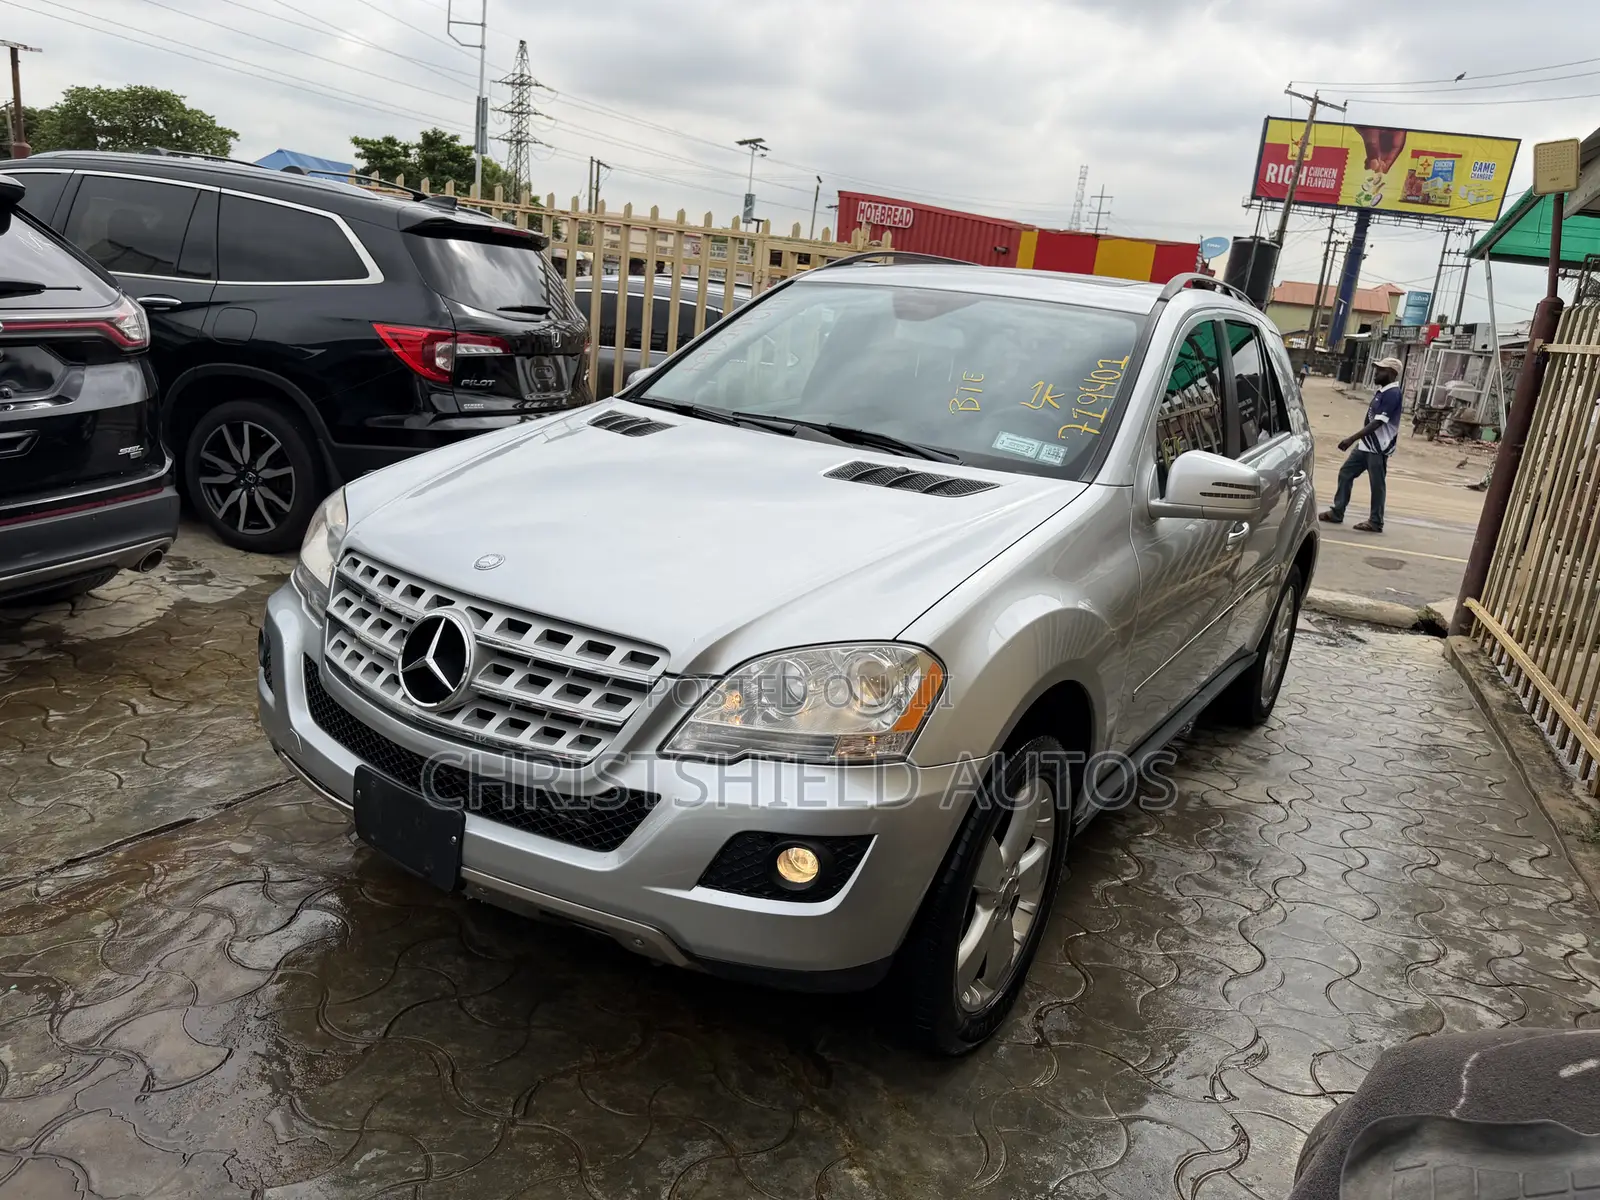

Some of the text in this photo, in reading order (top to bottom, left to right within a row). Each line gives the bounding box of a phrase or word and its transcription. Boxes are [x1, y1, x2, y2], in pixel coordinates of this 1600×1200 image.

[1265, 162, 1308, 186] RICH
[1309, 166, 1338, 179] CHICKEN
[1472, 161, 1496, 174] GAME
[1306, 177, 1336, 189] FLAVOUR
[879, 205, 911, 227] BREAD
[460, 379, 496, 387] PILOT
